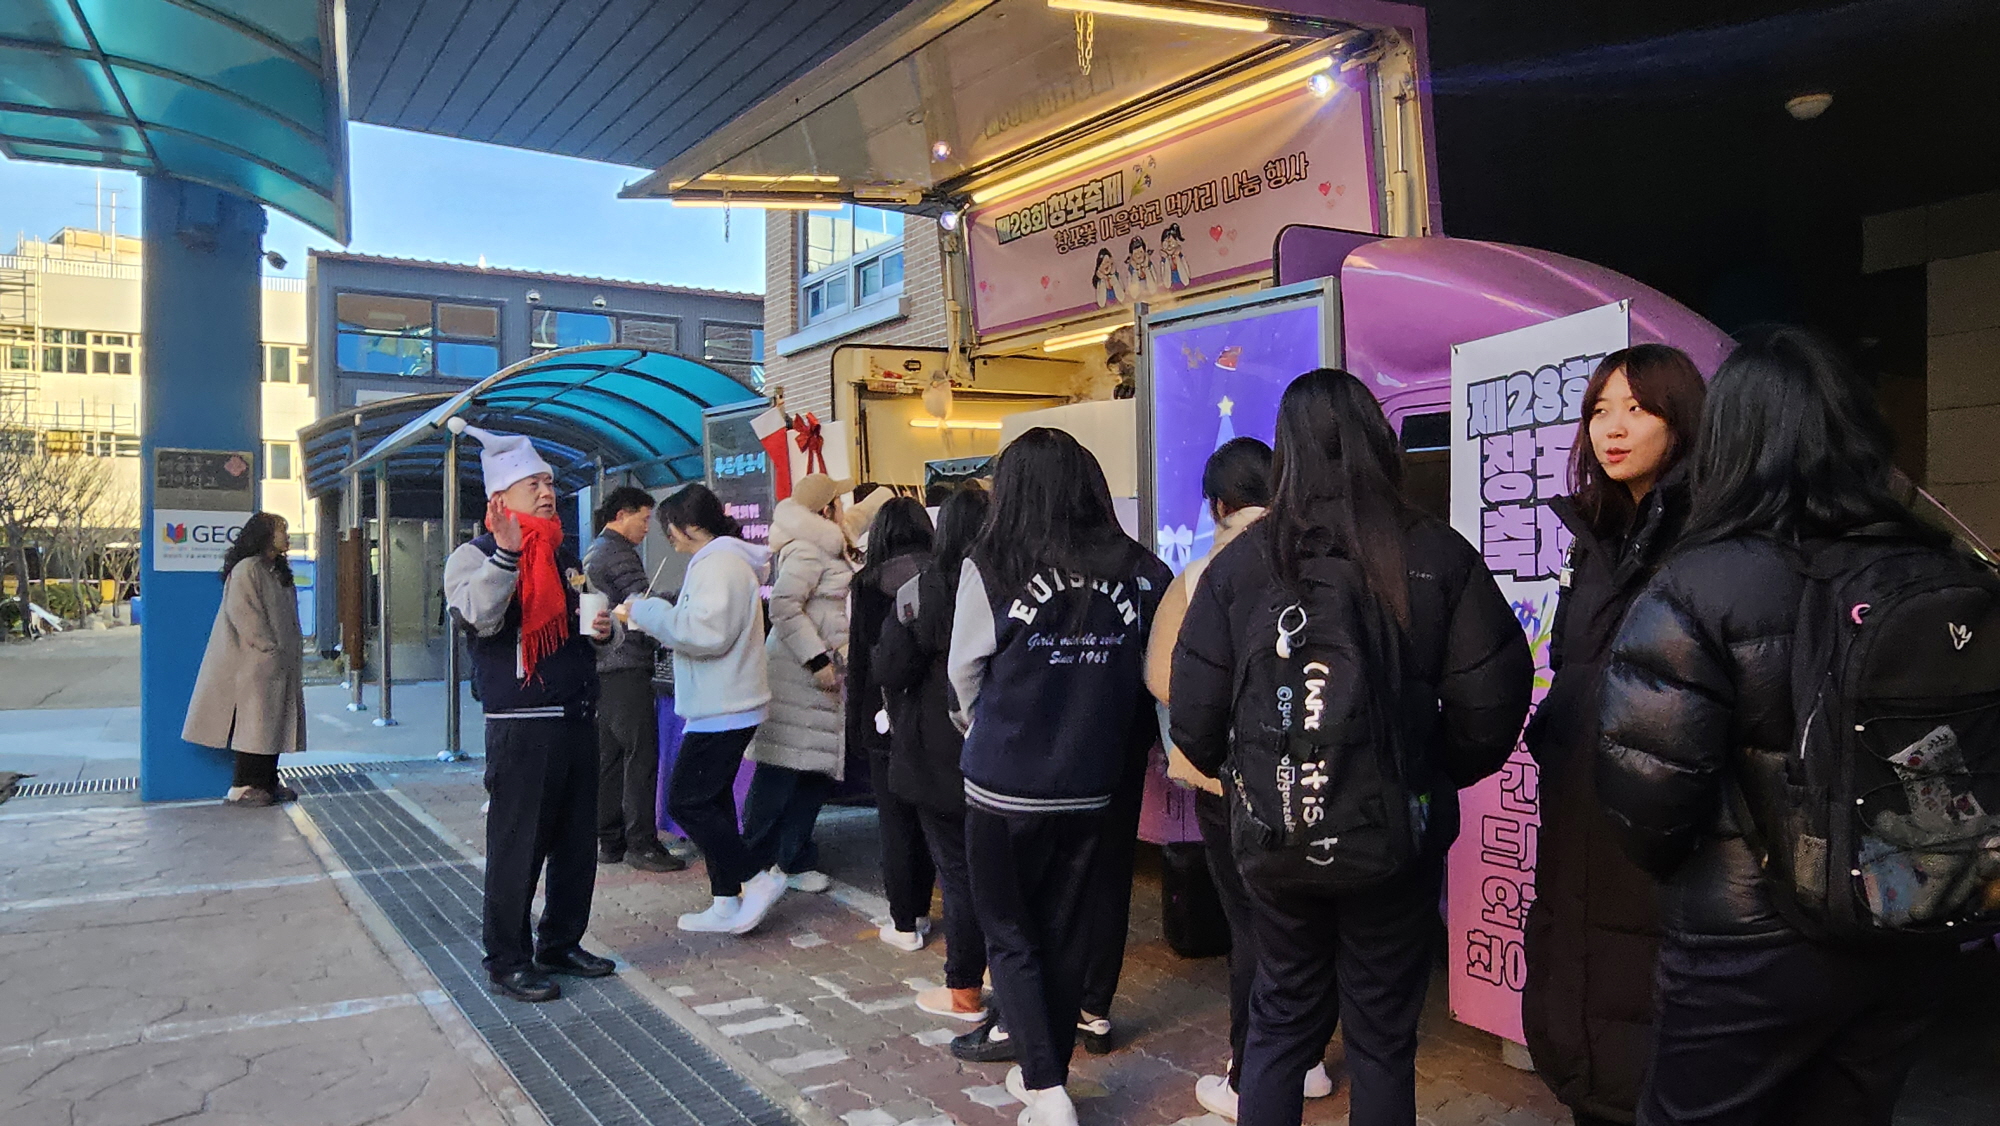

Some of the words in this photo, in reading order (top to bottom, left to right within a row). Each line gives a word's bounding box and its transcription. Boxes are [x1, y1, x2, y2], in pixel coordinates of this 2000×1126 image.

[995, 201, 1047, 245] 제28회
[1047, 170, 1124, 229] 창포축제
[1054, 221, 1098, 255] 창포꽃
[1100, 199, 1163, 242] 마을학교
[1165, 180, 1218, 218] 먹거리
[1221, 169, 1263, 204] 나눔
[1264, 151, 1310, 190] 행사
